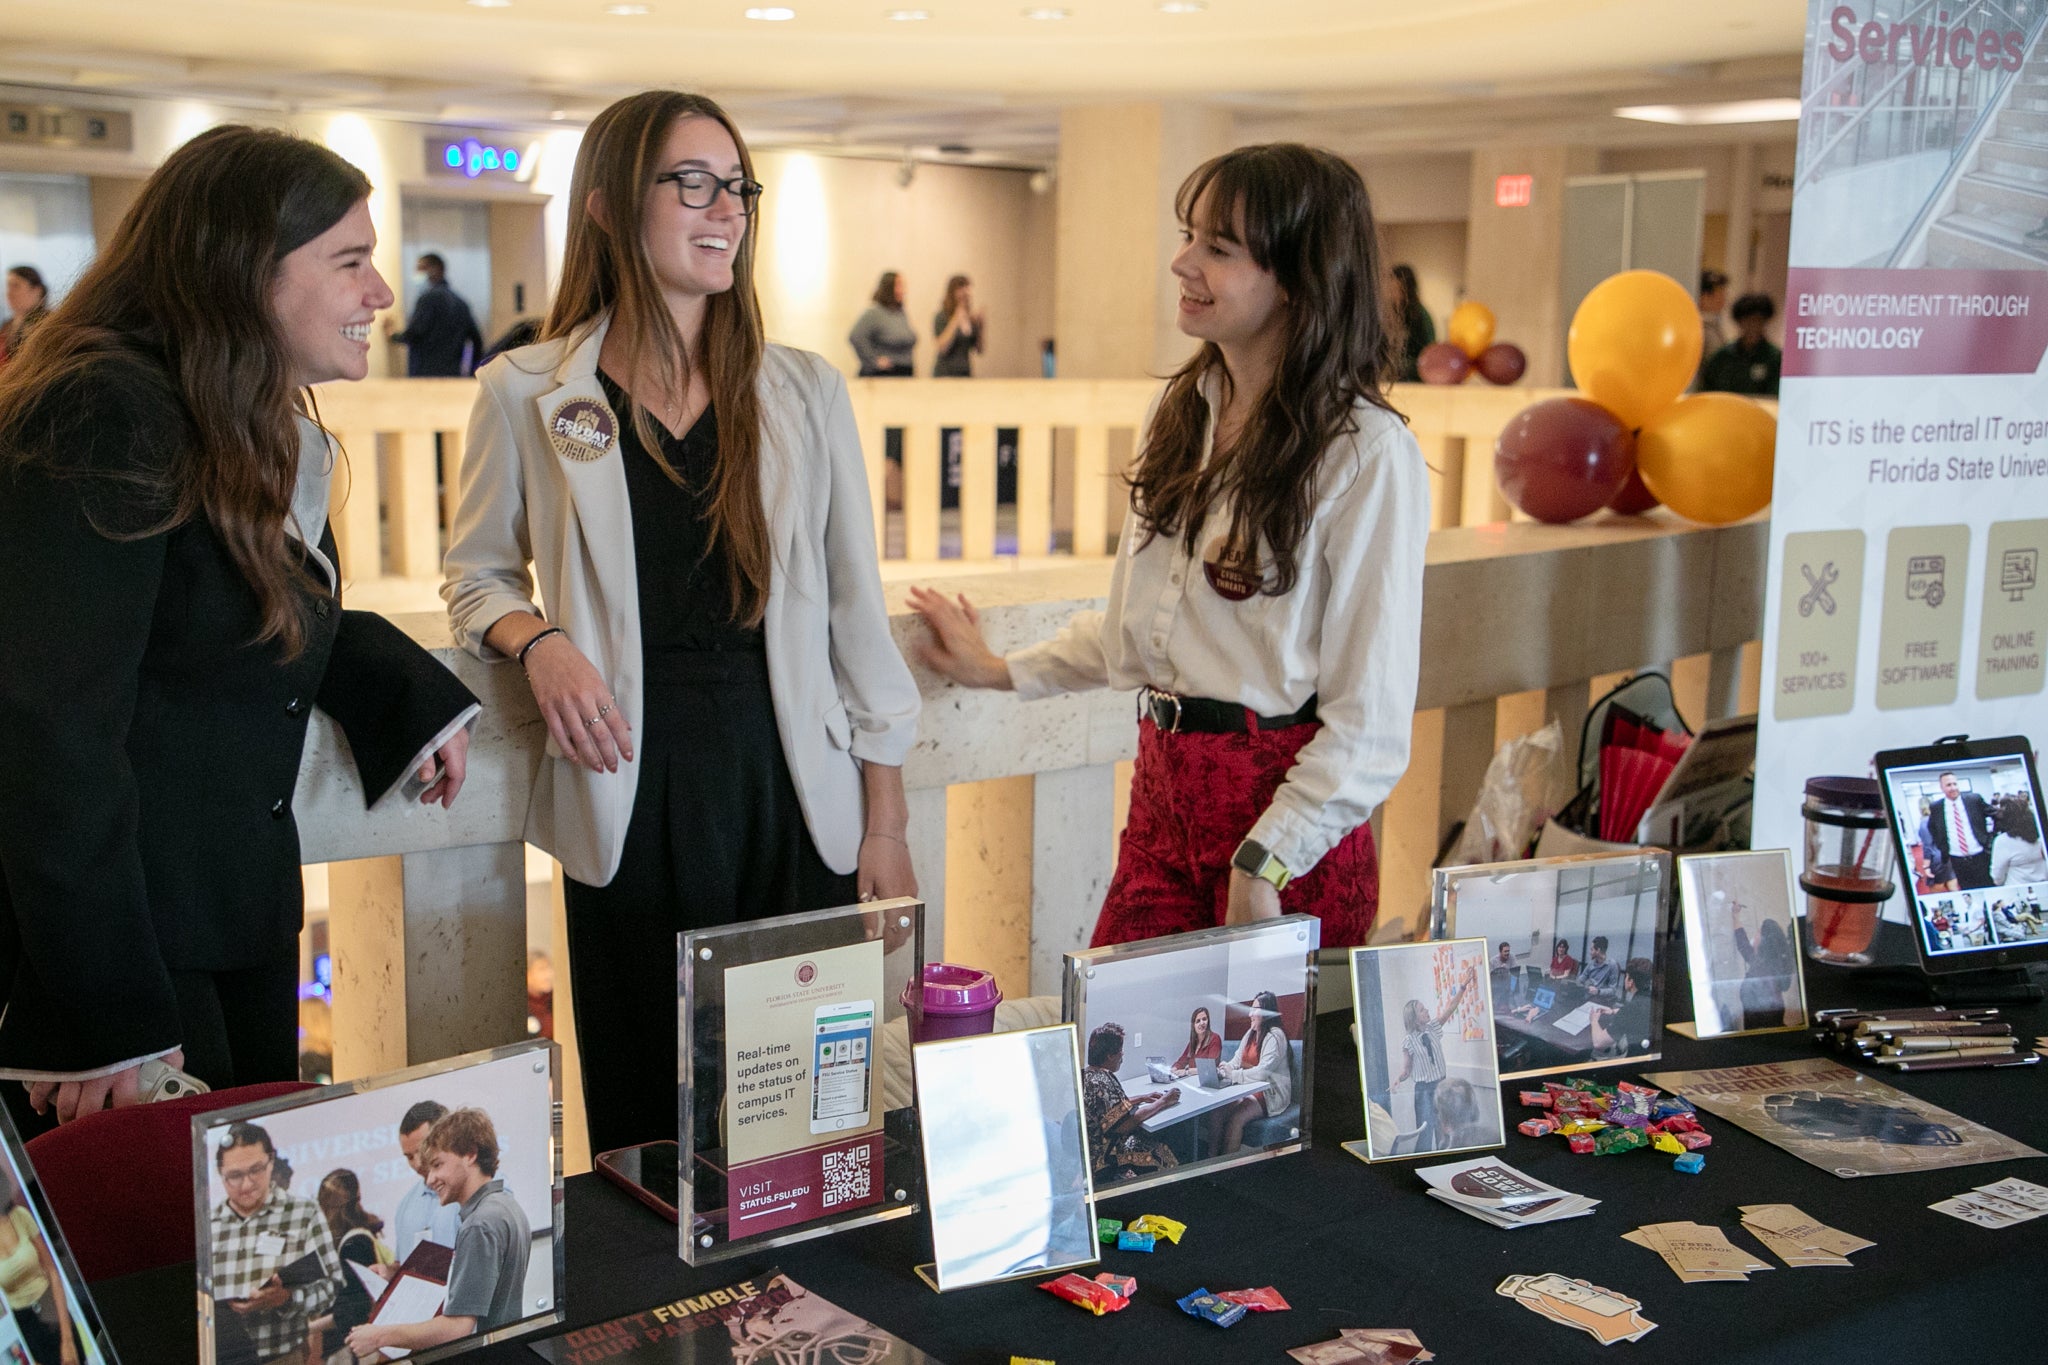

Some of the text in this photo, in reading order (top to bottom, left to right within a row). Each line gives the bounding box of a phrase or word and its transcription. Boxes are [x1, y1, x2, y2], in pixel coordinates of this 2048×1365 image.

[1827, 5, 2024, 72] Services
[1798, 293, 2030, 317] EMPOWERMENT THROUGH
[1796, 326, 1924, 349] TECHNOLOGY
[556, 417, 611, 443] FSU DAY
[1808, 420, 1842, 446] ITS
[1848, 419, 1865, 445] is
[1872, 418, 1905, 444] the
[1912, 416, 1979, 442] central
[1985, 416, 2003, 441] IT
[1868, 452, 2048, 484] Florida State Unive
[1904, 640, 1939, 659] FREE
[1992, 631, 2036, 651] ONLINE
[1800, 651, 1829, 667] 100+
[1986, 653, 2040, 673] TRAINING
[1782, 672, 1848, 694] SERVICES
[1881, 662, 1956, 686] SOFTWARE
[811, 983, 845, 994] UNIVERSITY
[737, 1043, 791, 1062] Real-time
[737, 1057, 799, 1079] updates on
[1691, 1063, 1788, 1083] TACKLE
[738, 1069, 806, 1094] the status of
[738, 1087, 796, 1110] campus IT
[738, 1108, 788, 1126] services.
[740, 1180, 773, 1198] VISIT
[1470, 1170, 1523, 1196] BOWL
[1486, 1170, 1534, 1193] CYBER
[740, 1185, 810, 1211] STATUS.FSU.EDU
[564, 1281, 762, 1349] DON'T FUMBLE
[564, 1334, 642, 1365] YOUR
